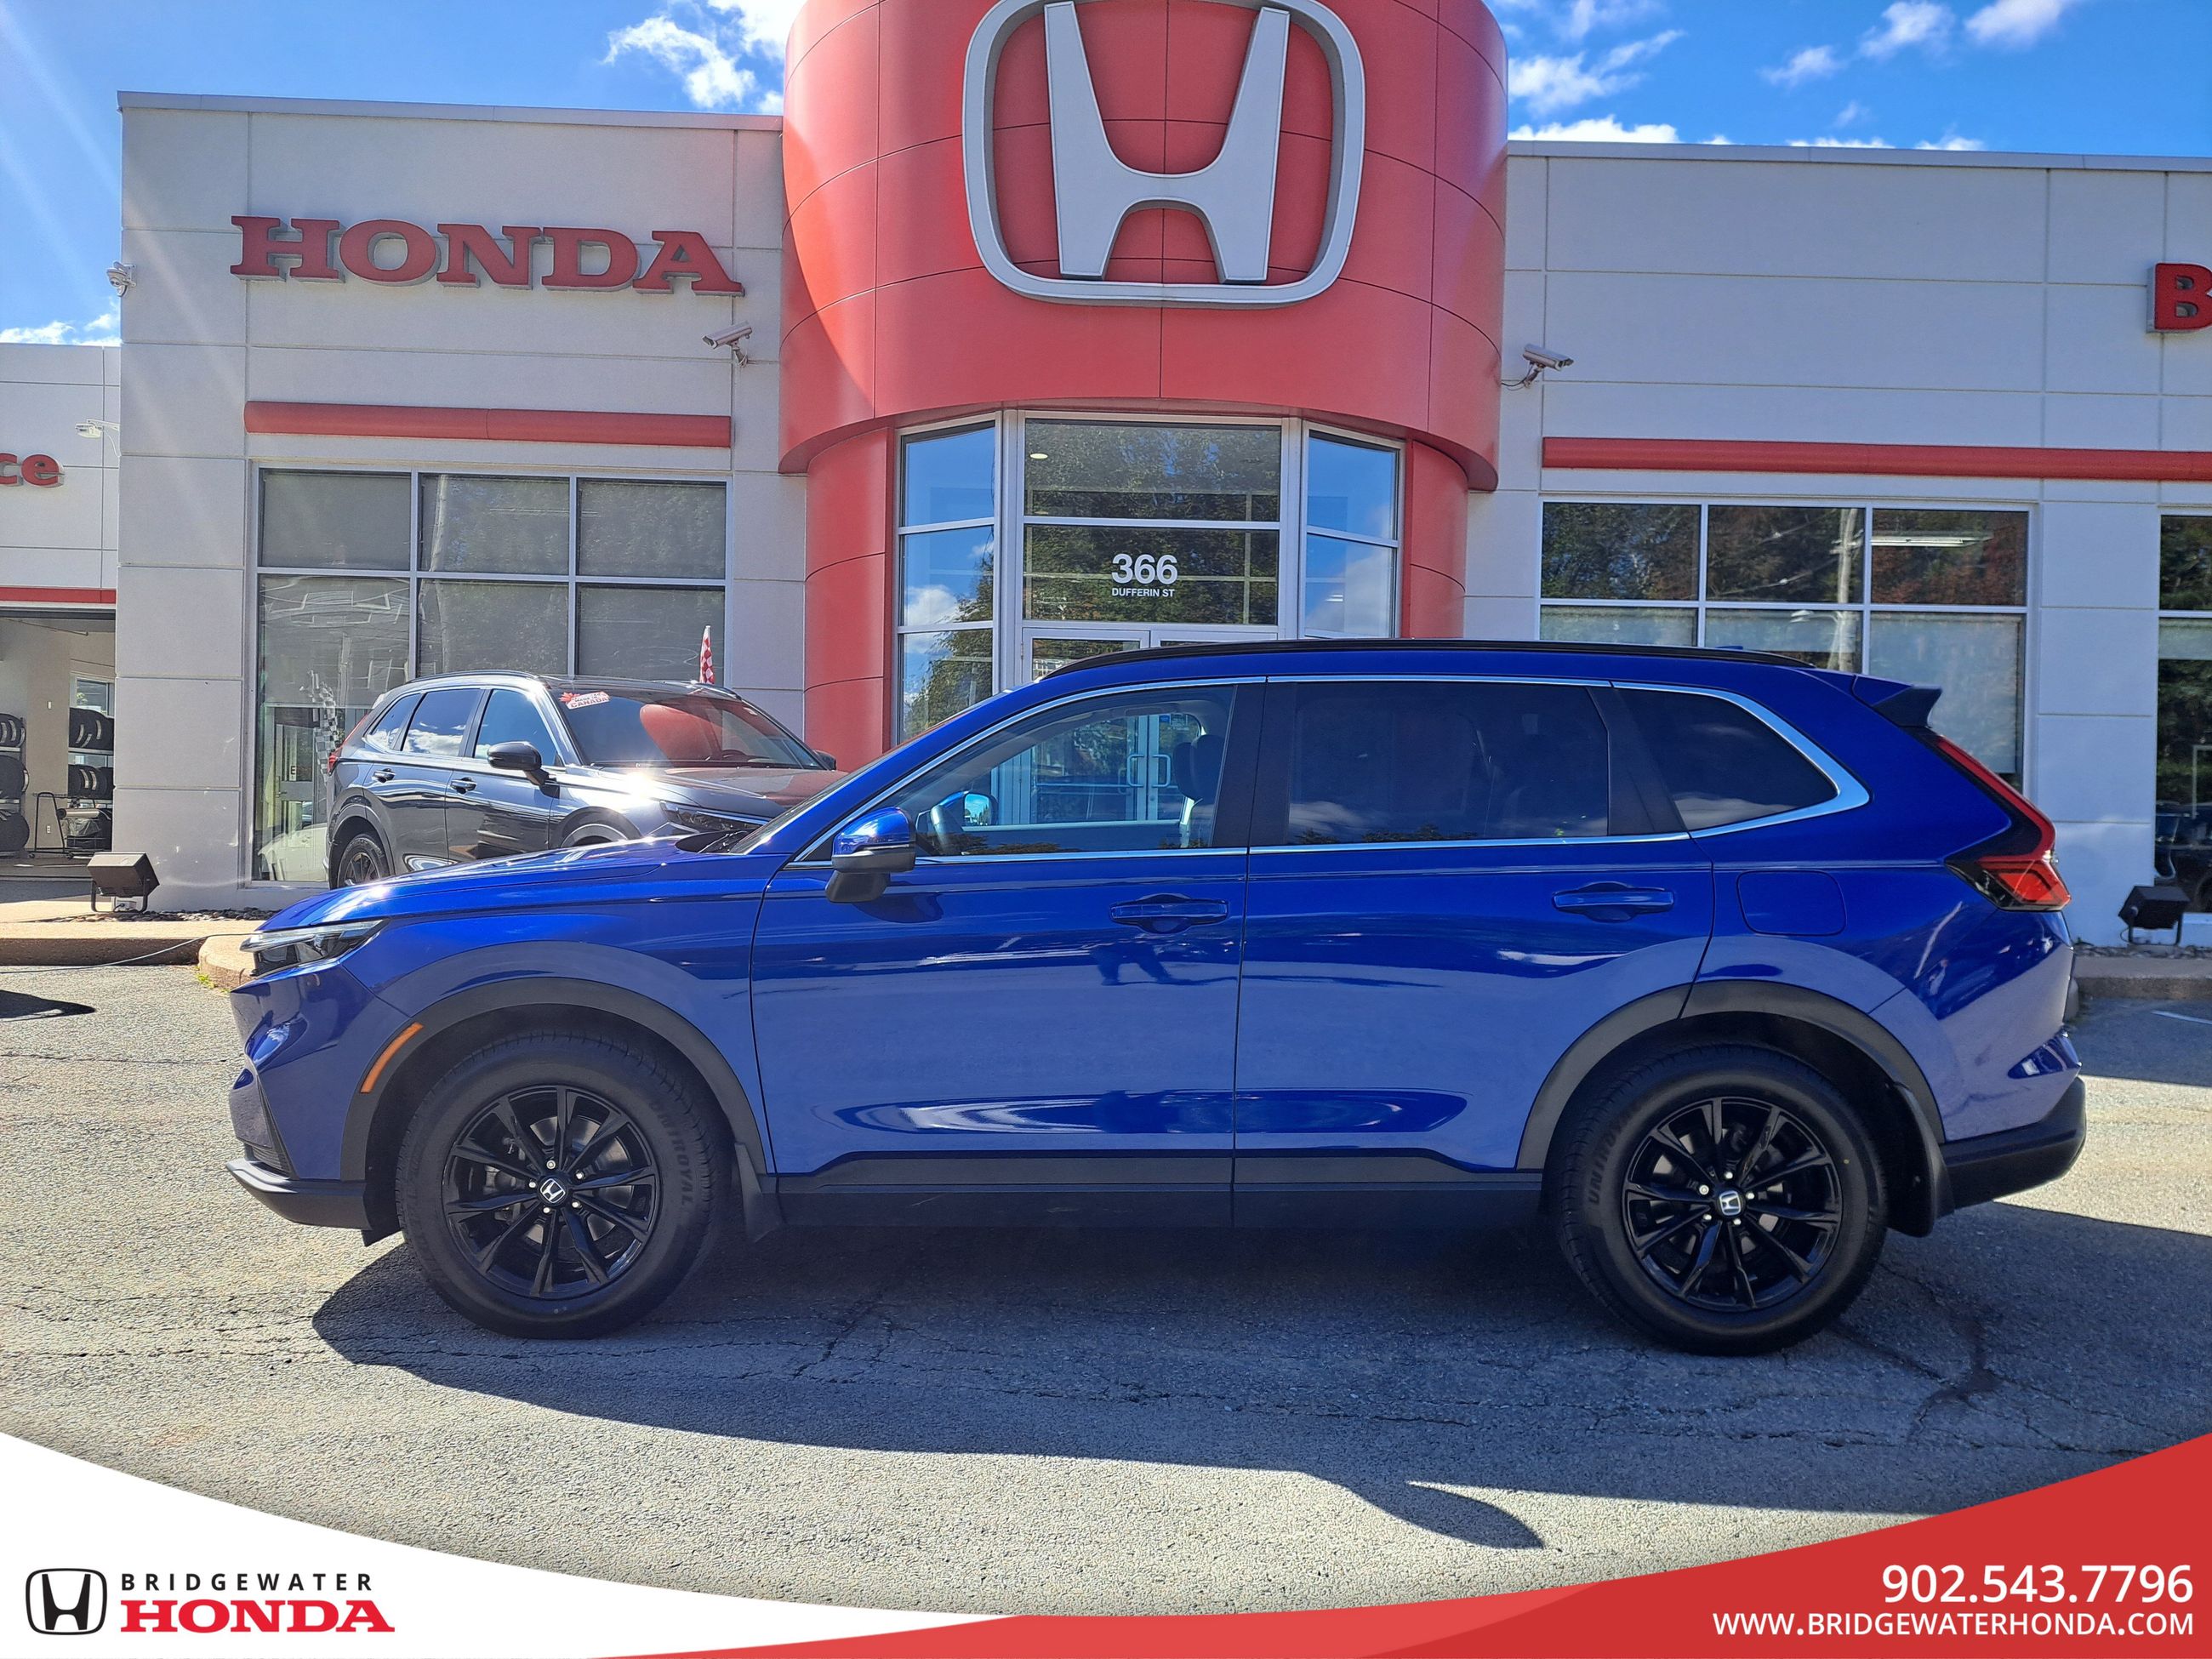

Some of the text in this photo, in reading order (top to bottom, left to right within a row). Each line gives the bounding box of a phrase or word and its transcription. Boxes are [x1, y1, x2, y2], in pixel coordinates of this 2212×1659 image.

[231, 214, 744, 295] HONDA
[1111, 553, 1178, 584] 366
[1111, 588, 1176, 597] DUFFERIN ST
